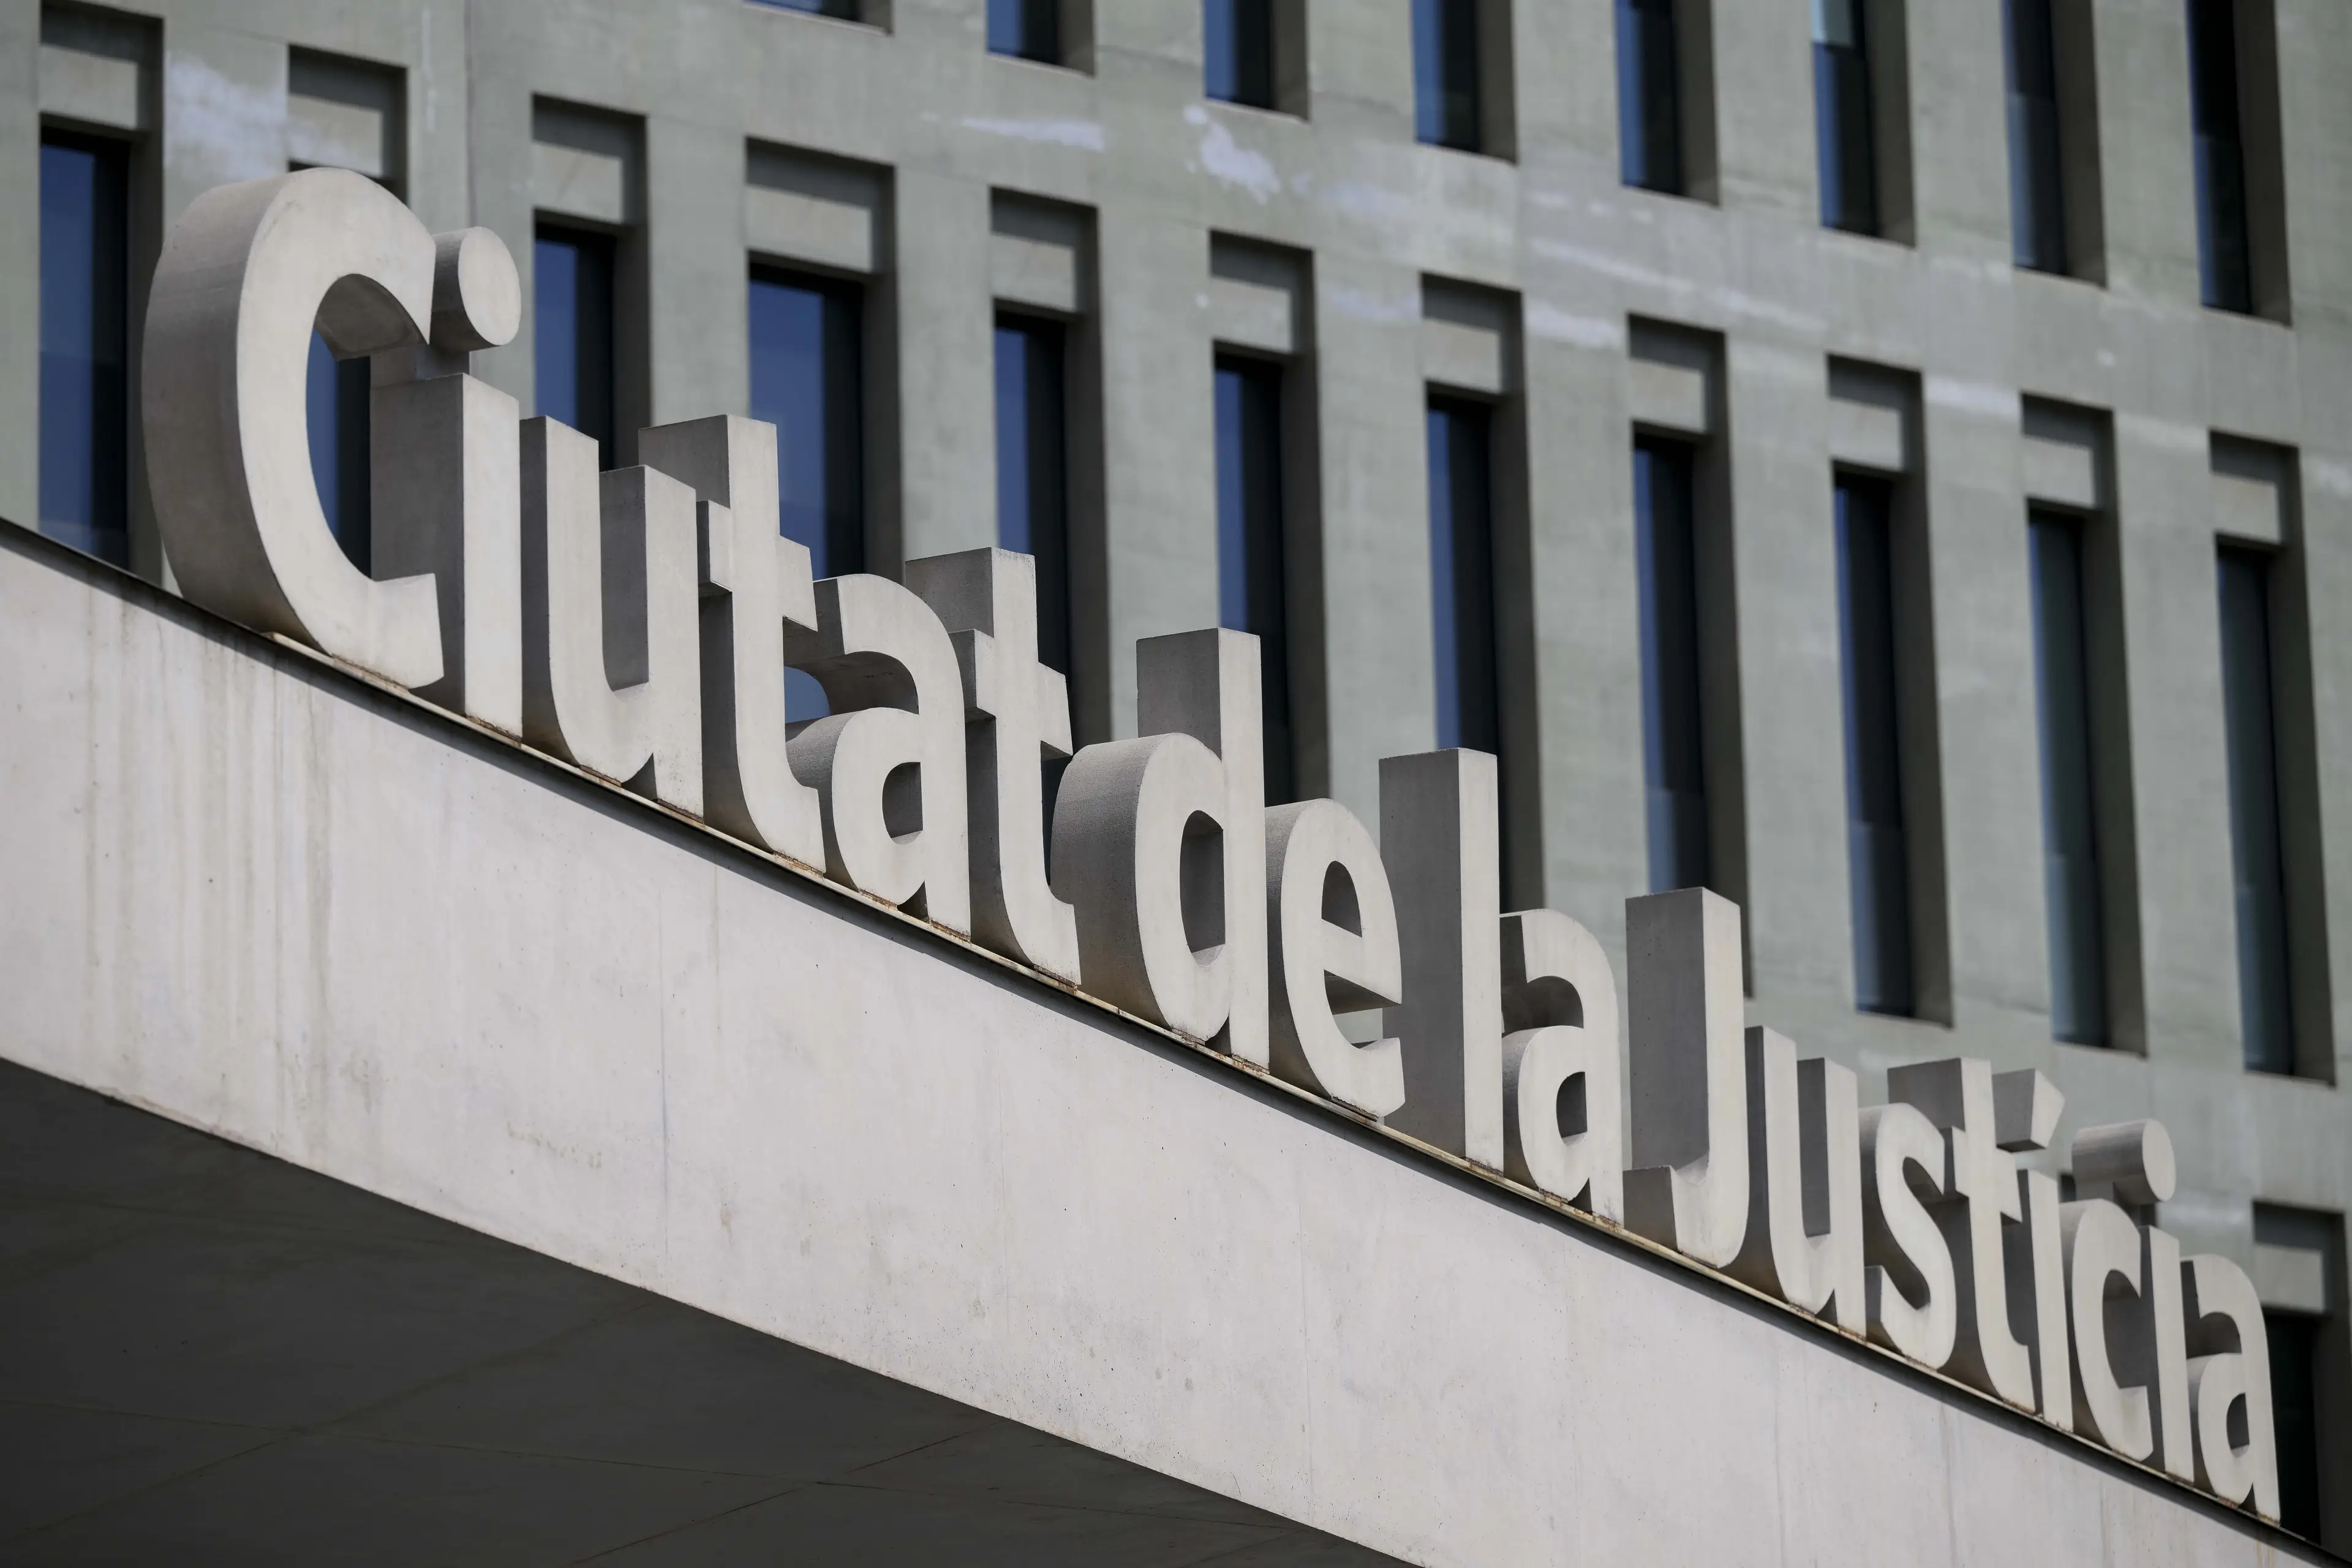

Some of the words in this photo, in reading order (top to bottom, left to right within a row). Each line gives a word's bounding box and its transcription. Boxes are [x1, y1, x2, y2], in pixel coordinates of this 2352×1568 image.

[237, 167, 1081, 986] Ciutat
[1135, 627, 1406, 1118] de
[1458, 747, 1624, 1229] la
[1671, 887, 2280, 1524] Justícia
